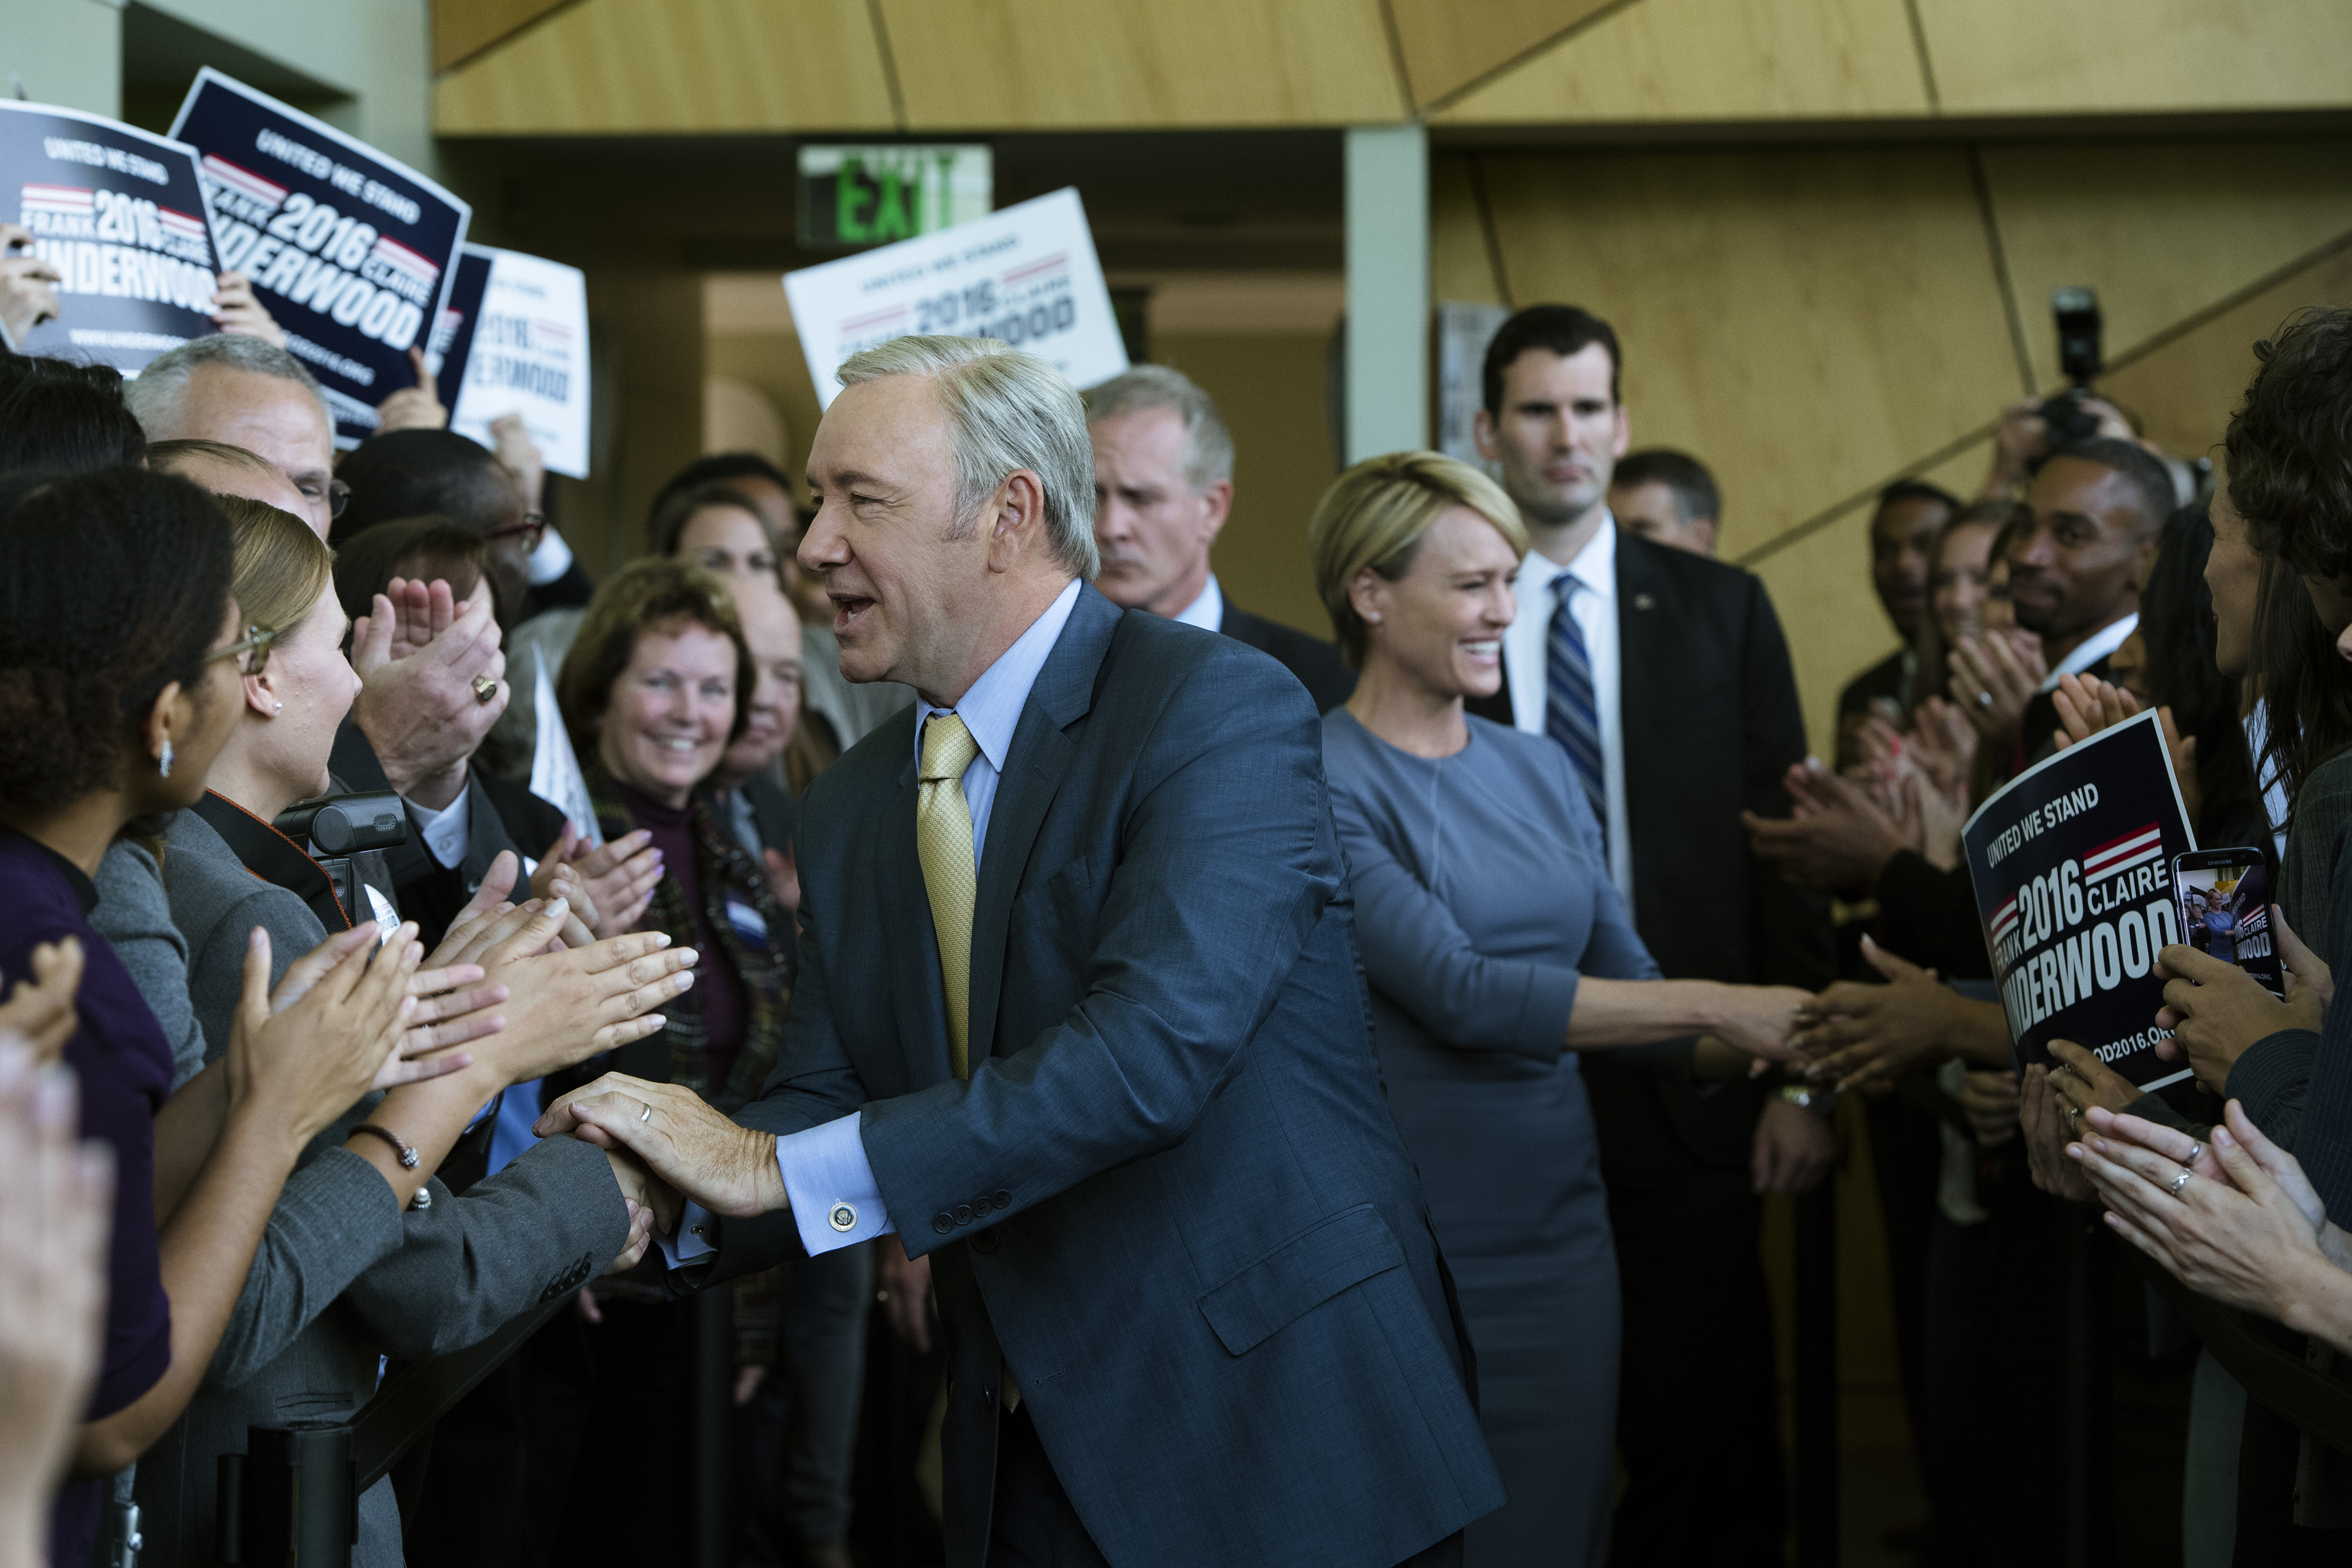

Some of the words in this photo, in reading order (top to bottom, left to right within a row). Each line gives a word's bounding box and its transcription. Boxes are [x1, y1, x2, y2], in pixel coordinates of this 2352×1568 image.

[43, 136, 107, 167] UNITED
[106, 146, 129, 174] WE
[127, 152, 169, 186] STAND
[255, 128, 333, 180] UNITED
[330, 163, 366, 197] WE
[361, 179, 421, 225] STAND
[836, 150, 956, 244] EXIT
[20, 210, 96, 238] FRANK
[94, 189, 163, 252] 2016
[267, 192, 378, 270] 2016
[360, 255, 436, 308] CLAIRE
[917, 278, 998, 334] 2016
[1987, 824, 2021, 870] UNITED
[2020, 809, 2044, 842] WE
[2044, 783, 2099, 828] STAND
[1995, 928, 2023, 977] FRANK
[2019, 858, 2084, 952] 2016
[2087, 858, 2170, 916] CLAIRE
[2244, 916, 2268, 936] CLAIRE
